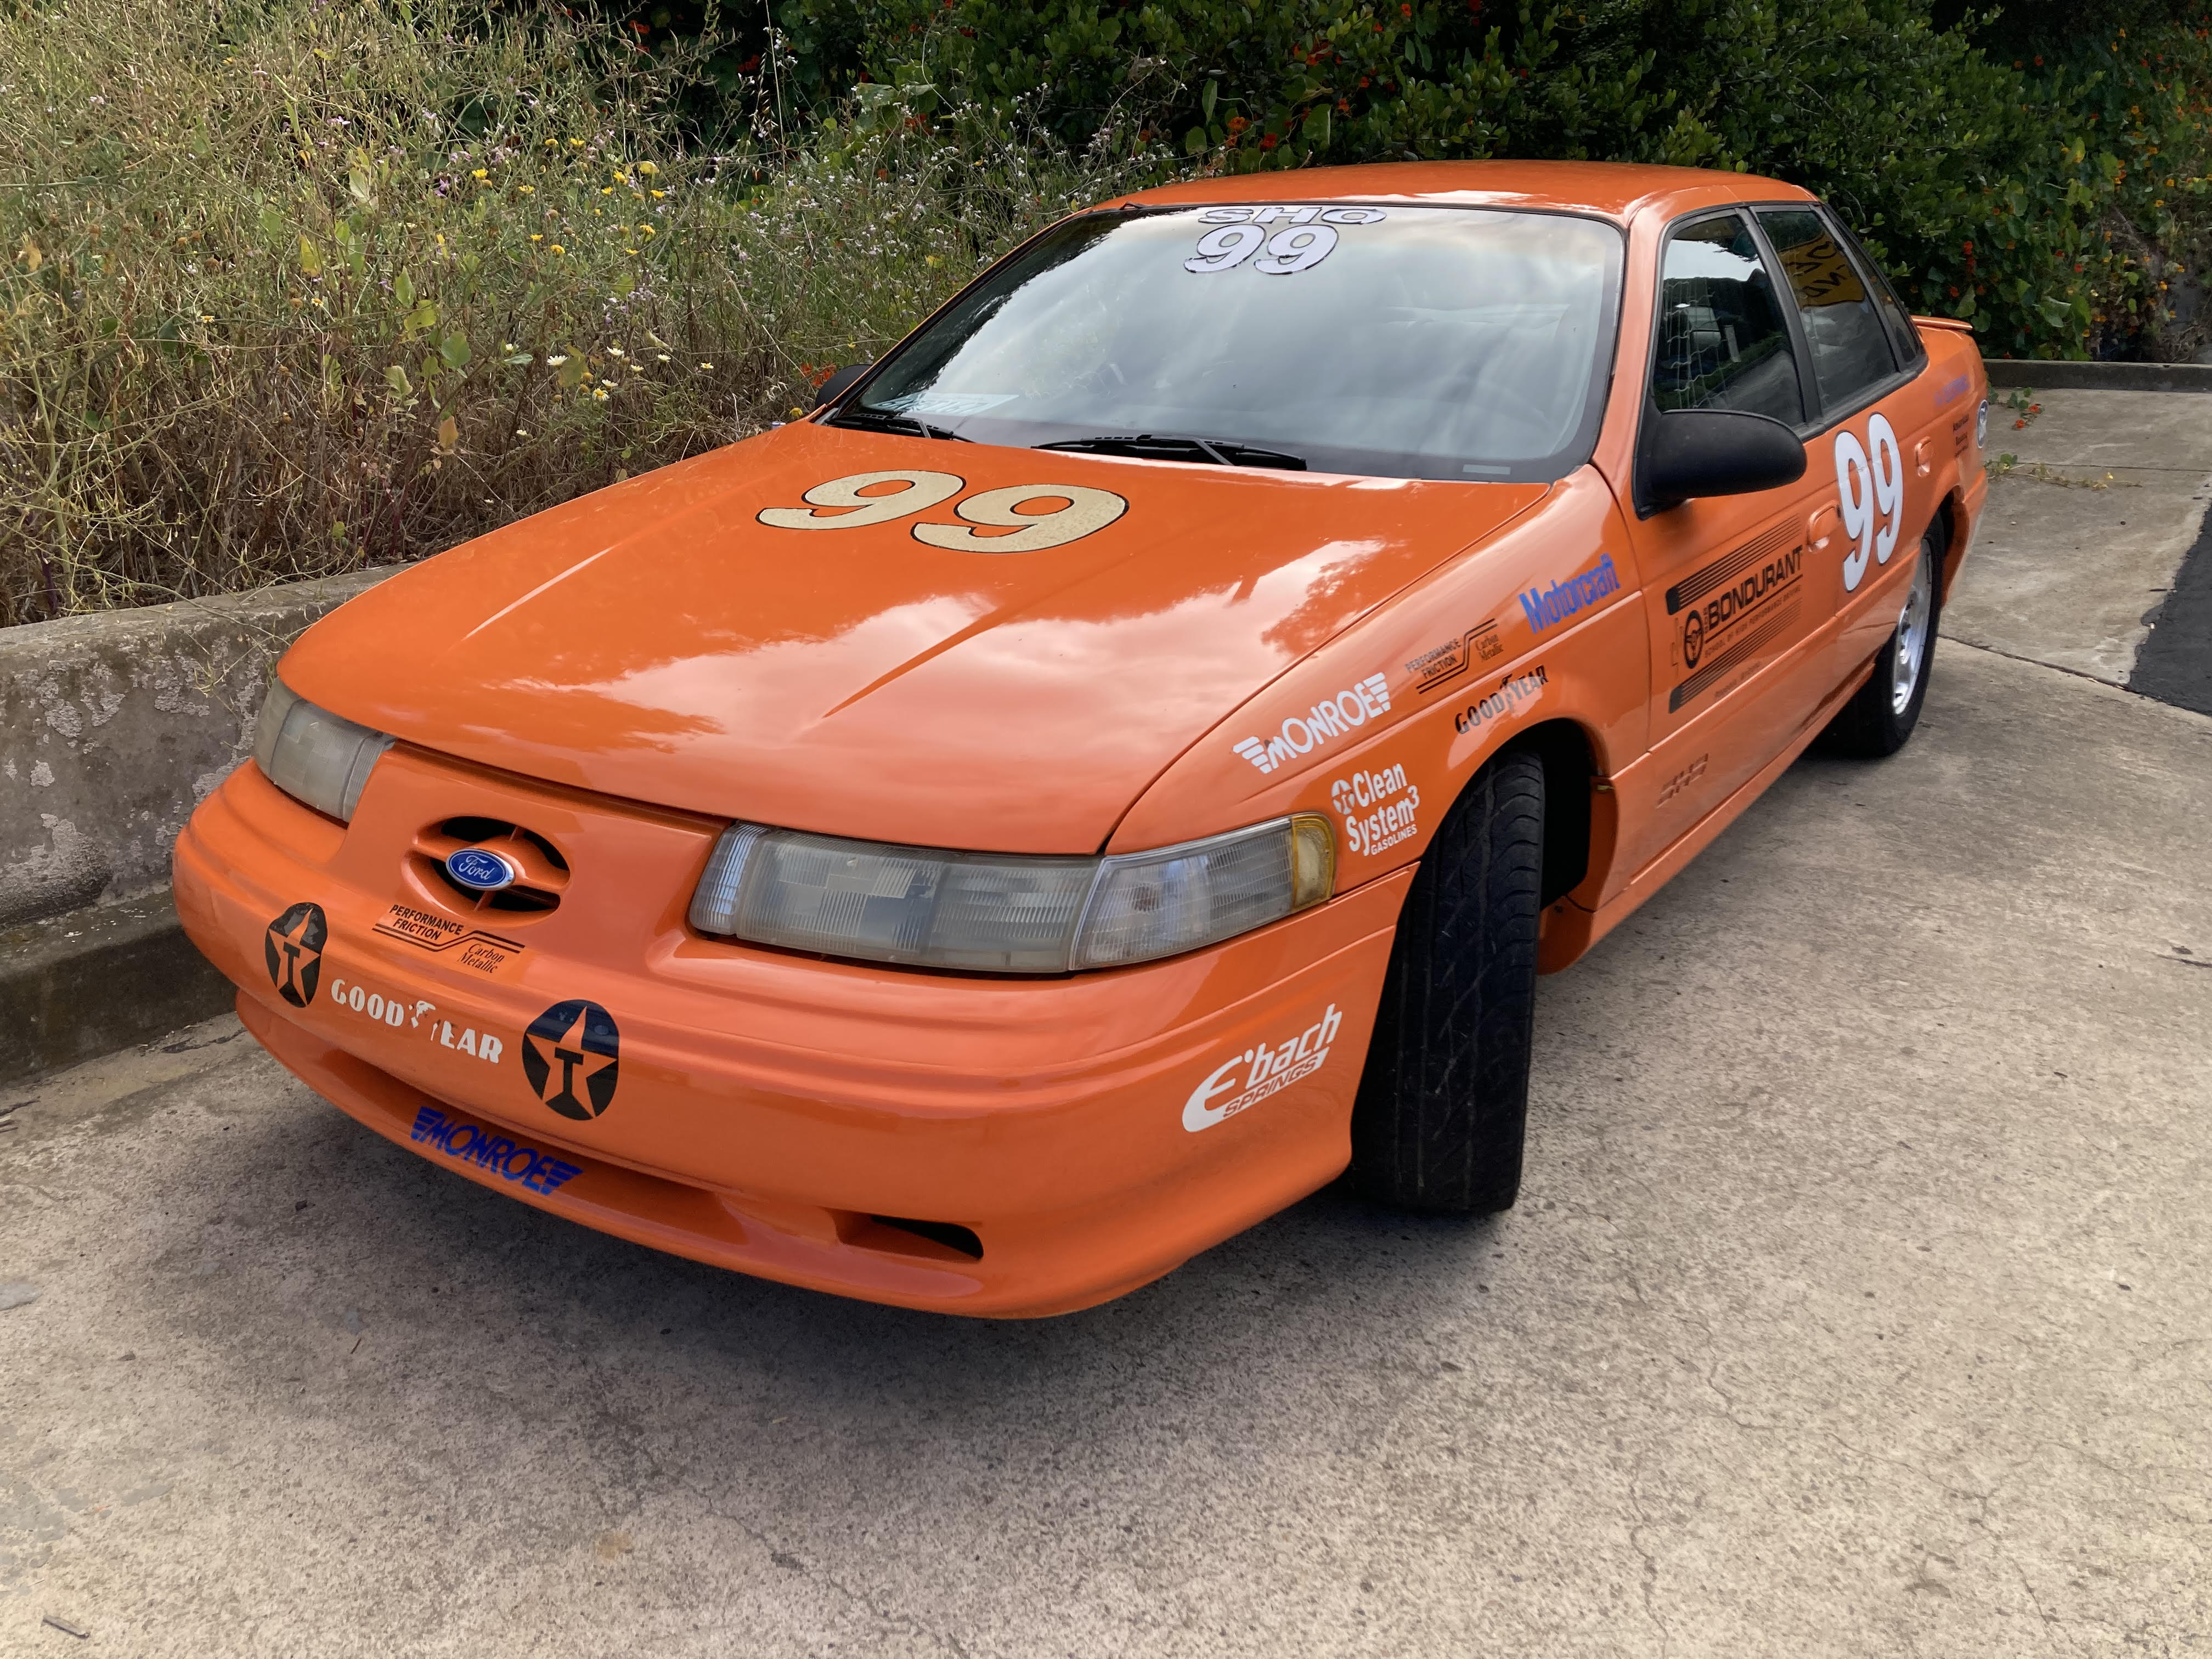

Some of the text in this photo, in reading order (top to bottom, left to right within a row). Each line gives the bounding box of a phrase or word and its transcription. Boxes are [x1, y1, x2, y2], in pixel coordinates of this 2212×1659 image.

[1198, 206, 1387, 224] SHO
[1183, 224, 1339, 275] 99
[755, 469, 1130, 554] 99
[1833, 411, 1903, 593] 99
[1518, 552, 1621, 634] Motorcraft
[1707, 544, 1803, 631] BONDURANT
[1421, 653, 1458, 679] FRICTION
[1267, 682, 1384, 769] MONROE
[1352, 763, 1407, 807] Clean
[1370, 824, 1418, 855] GASOLINES
[458, 855, 495, 881] Ford
[389, 904, 464, 935] PERFORMANCE
[393, 918, 442, 940] FRICTION
[456, 952, 498, 973] Metallic
[468, 943, 505, 962] Carbon
[331, 979, 503, 1064] GOODEAR
[1182, 1003, 1343, 1132] Ebach
[1223, 1054, 1319, 1118] SPRINGS
[419, 1114, 555, 1193] MONROE
